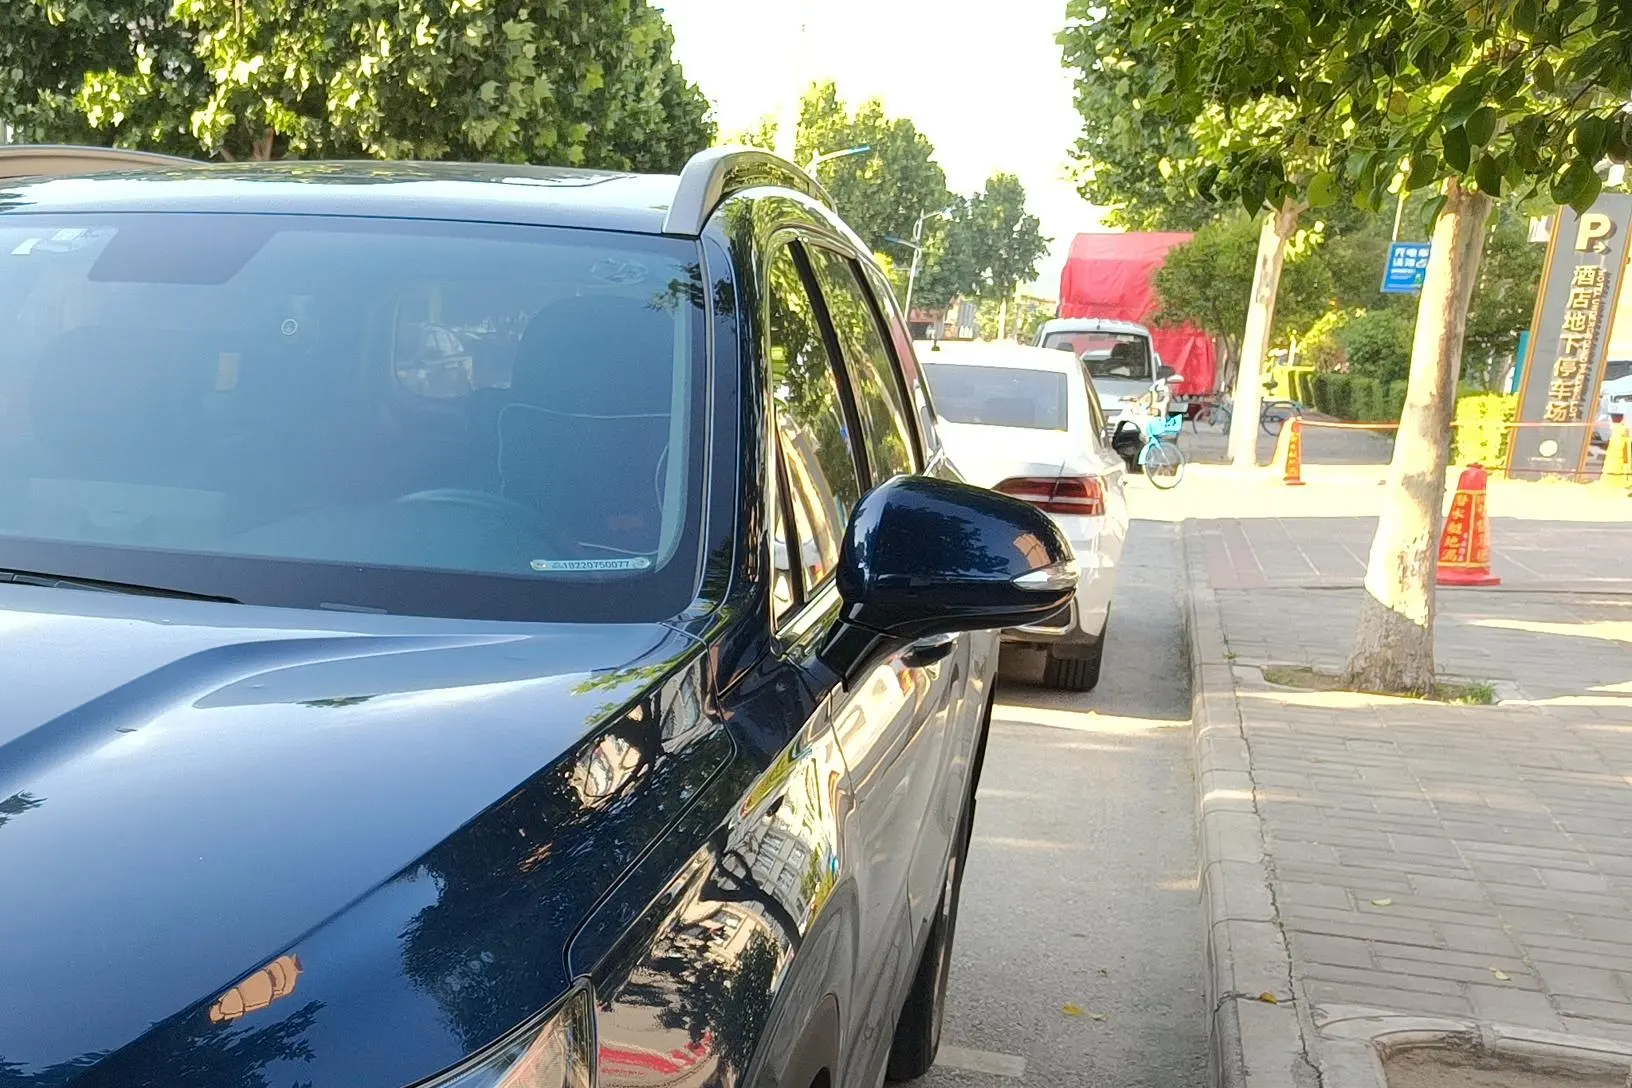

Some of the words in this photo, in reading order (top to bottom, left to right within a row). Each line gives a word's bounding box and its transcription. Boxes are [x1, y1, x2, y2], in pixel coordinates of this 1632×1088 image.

[1575, 213, 1611, 250] P
[1544, 265, 1600, 421] 酒店地下停车场
